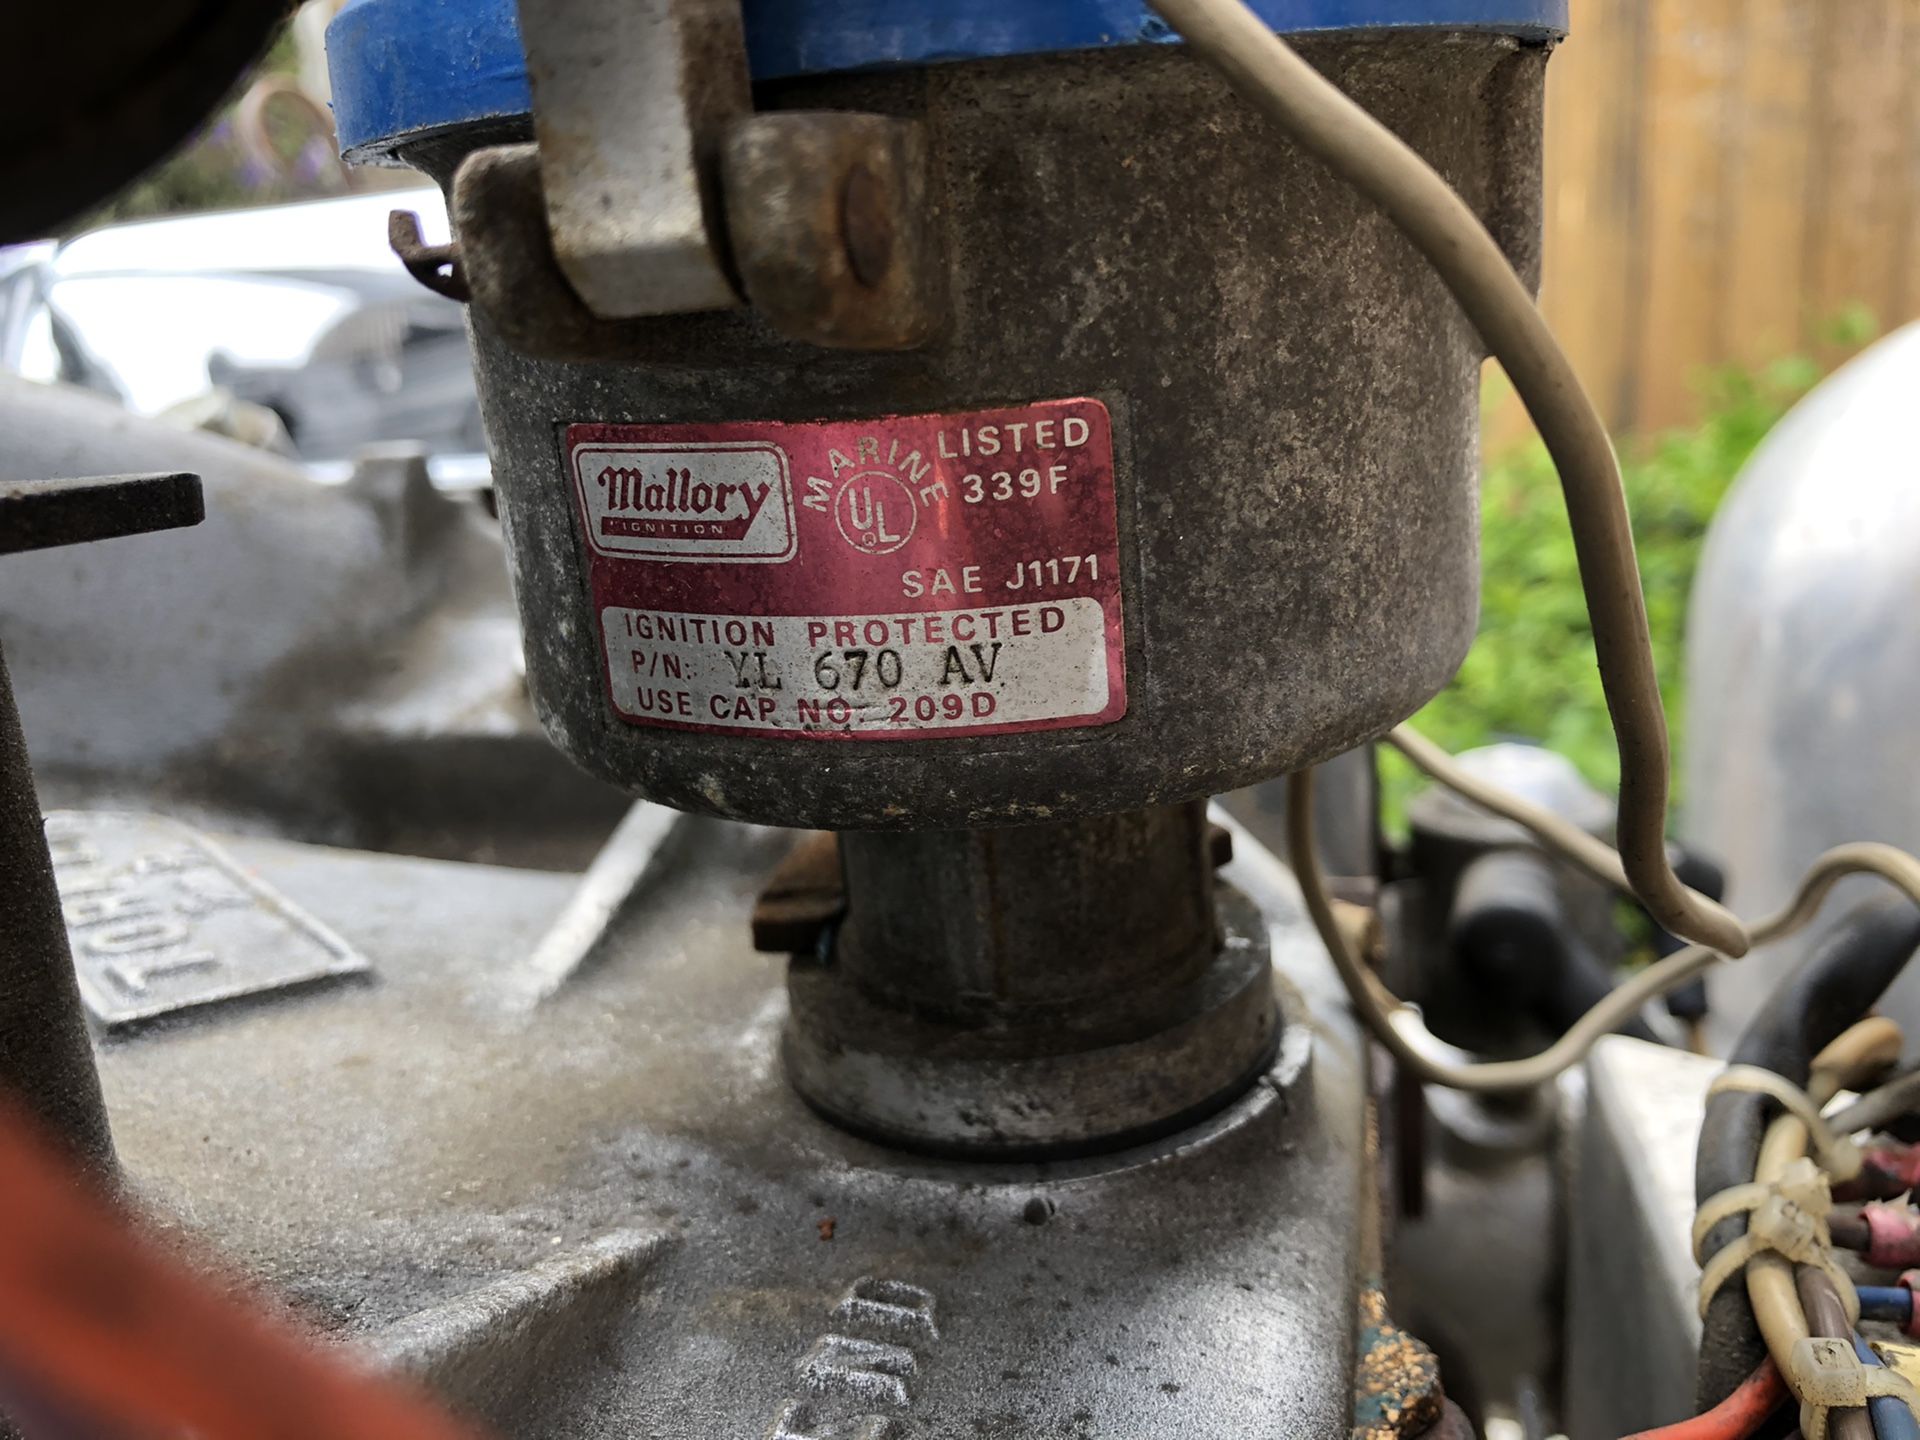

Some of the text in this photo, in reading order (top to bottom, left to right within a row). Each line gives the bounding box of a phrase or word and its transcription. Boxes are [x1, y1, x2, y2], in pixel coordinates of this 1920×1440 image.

[938, 417, 1090, 459] LISTED
[597, 465, 771, 521] Mallory
[803, 436, 949, 512] MARINE
[962, 465, 1068, 504] 339F
[622, 521, 724, 535] IGNITION
[848, 487, 900, 543] UL
[902, 553, 1099, 598] SAE J1171
[624, 606, 1066, 648] IGNITION PROTECTED
[814, 649, 903, 690] 670
[940, 643, 1003, 685] AV
[637, 686, 693, 716] USE
[709, 694, 777, 722] CAP
[887, 691, 997, 722] 209D
